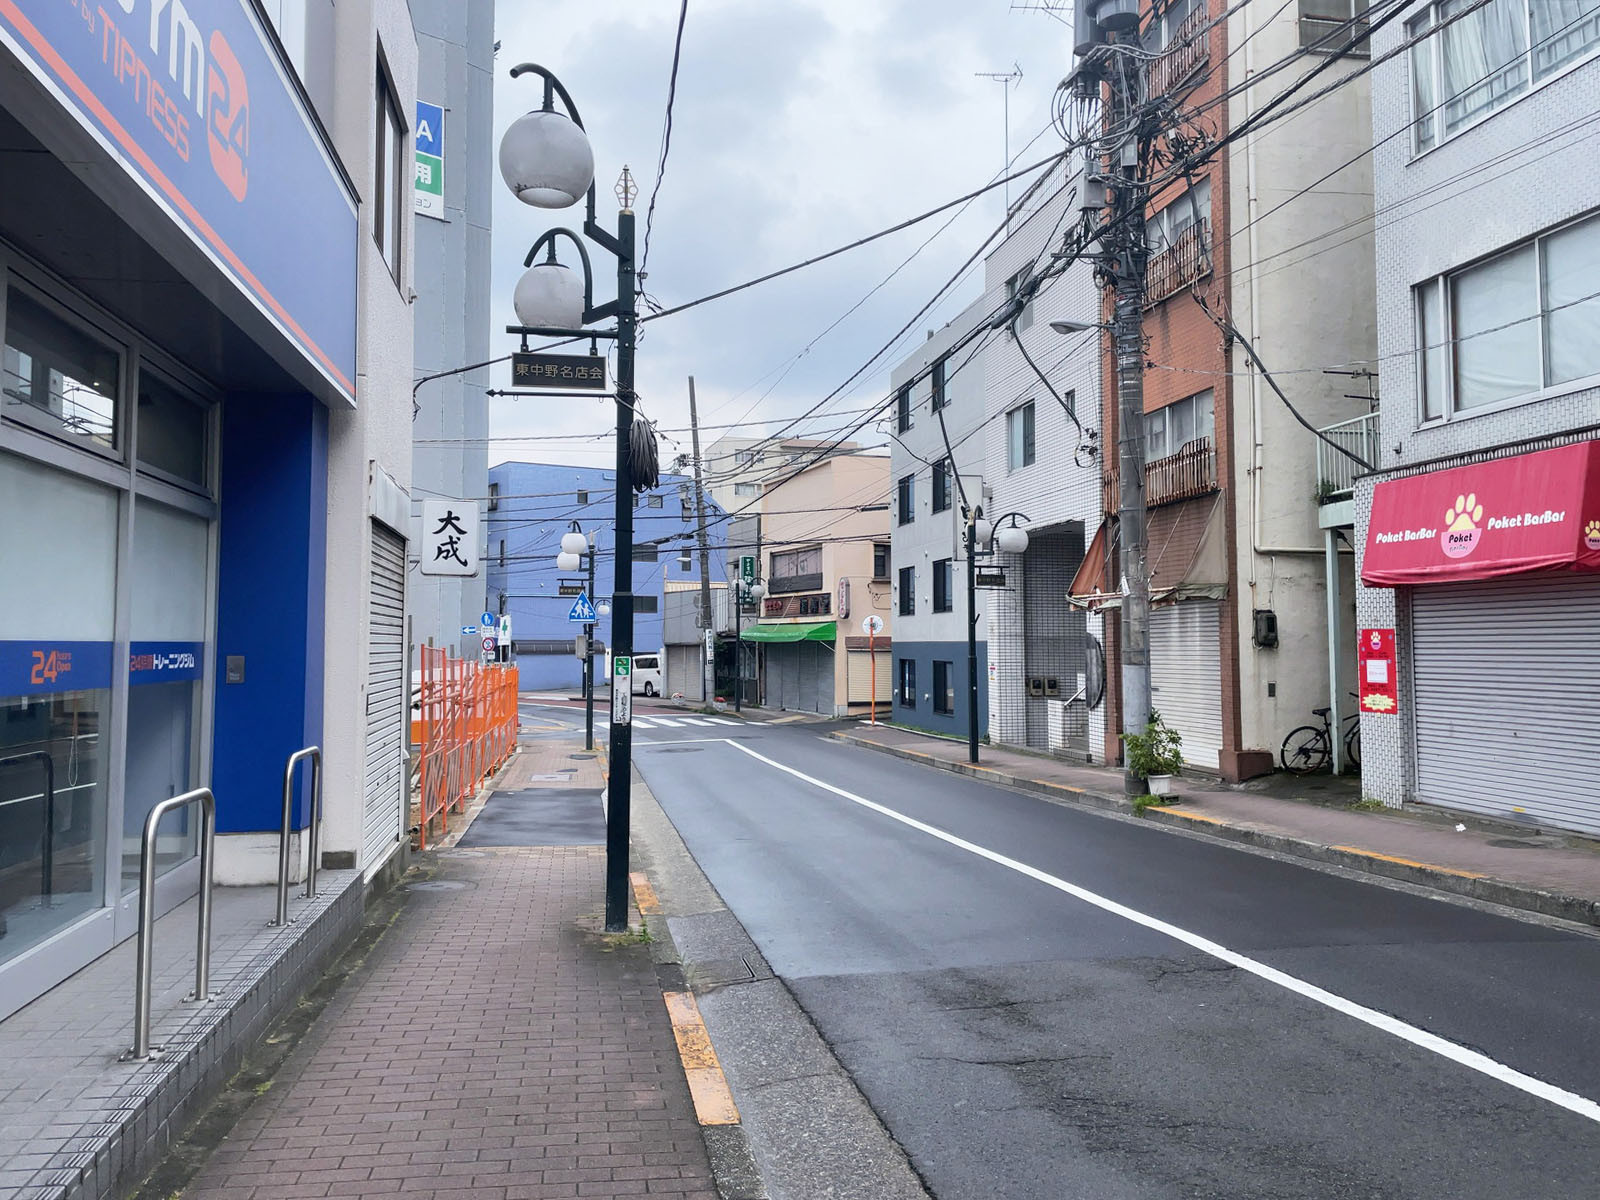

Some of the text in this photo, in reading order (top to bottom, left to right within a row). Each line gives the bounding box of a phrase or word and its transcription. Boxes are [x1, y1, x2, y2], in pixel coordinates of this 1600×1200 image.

[515, 363, 602, 379] 東中野名店会
[1487, 510, 1566, 530] Poket BarBar
[432, 510, 468, 567] 大成
[1375, 528, 1437, 544] Poket BarBar
[1448, 532, 1472, 544] Poket
[31, 650, 57, 684] 24
